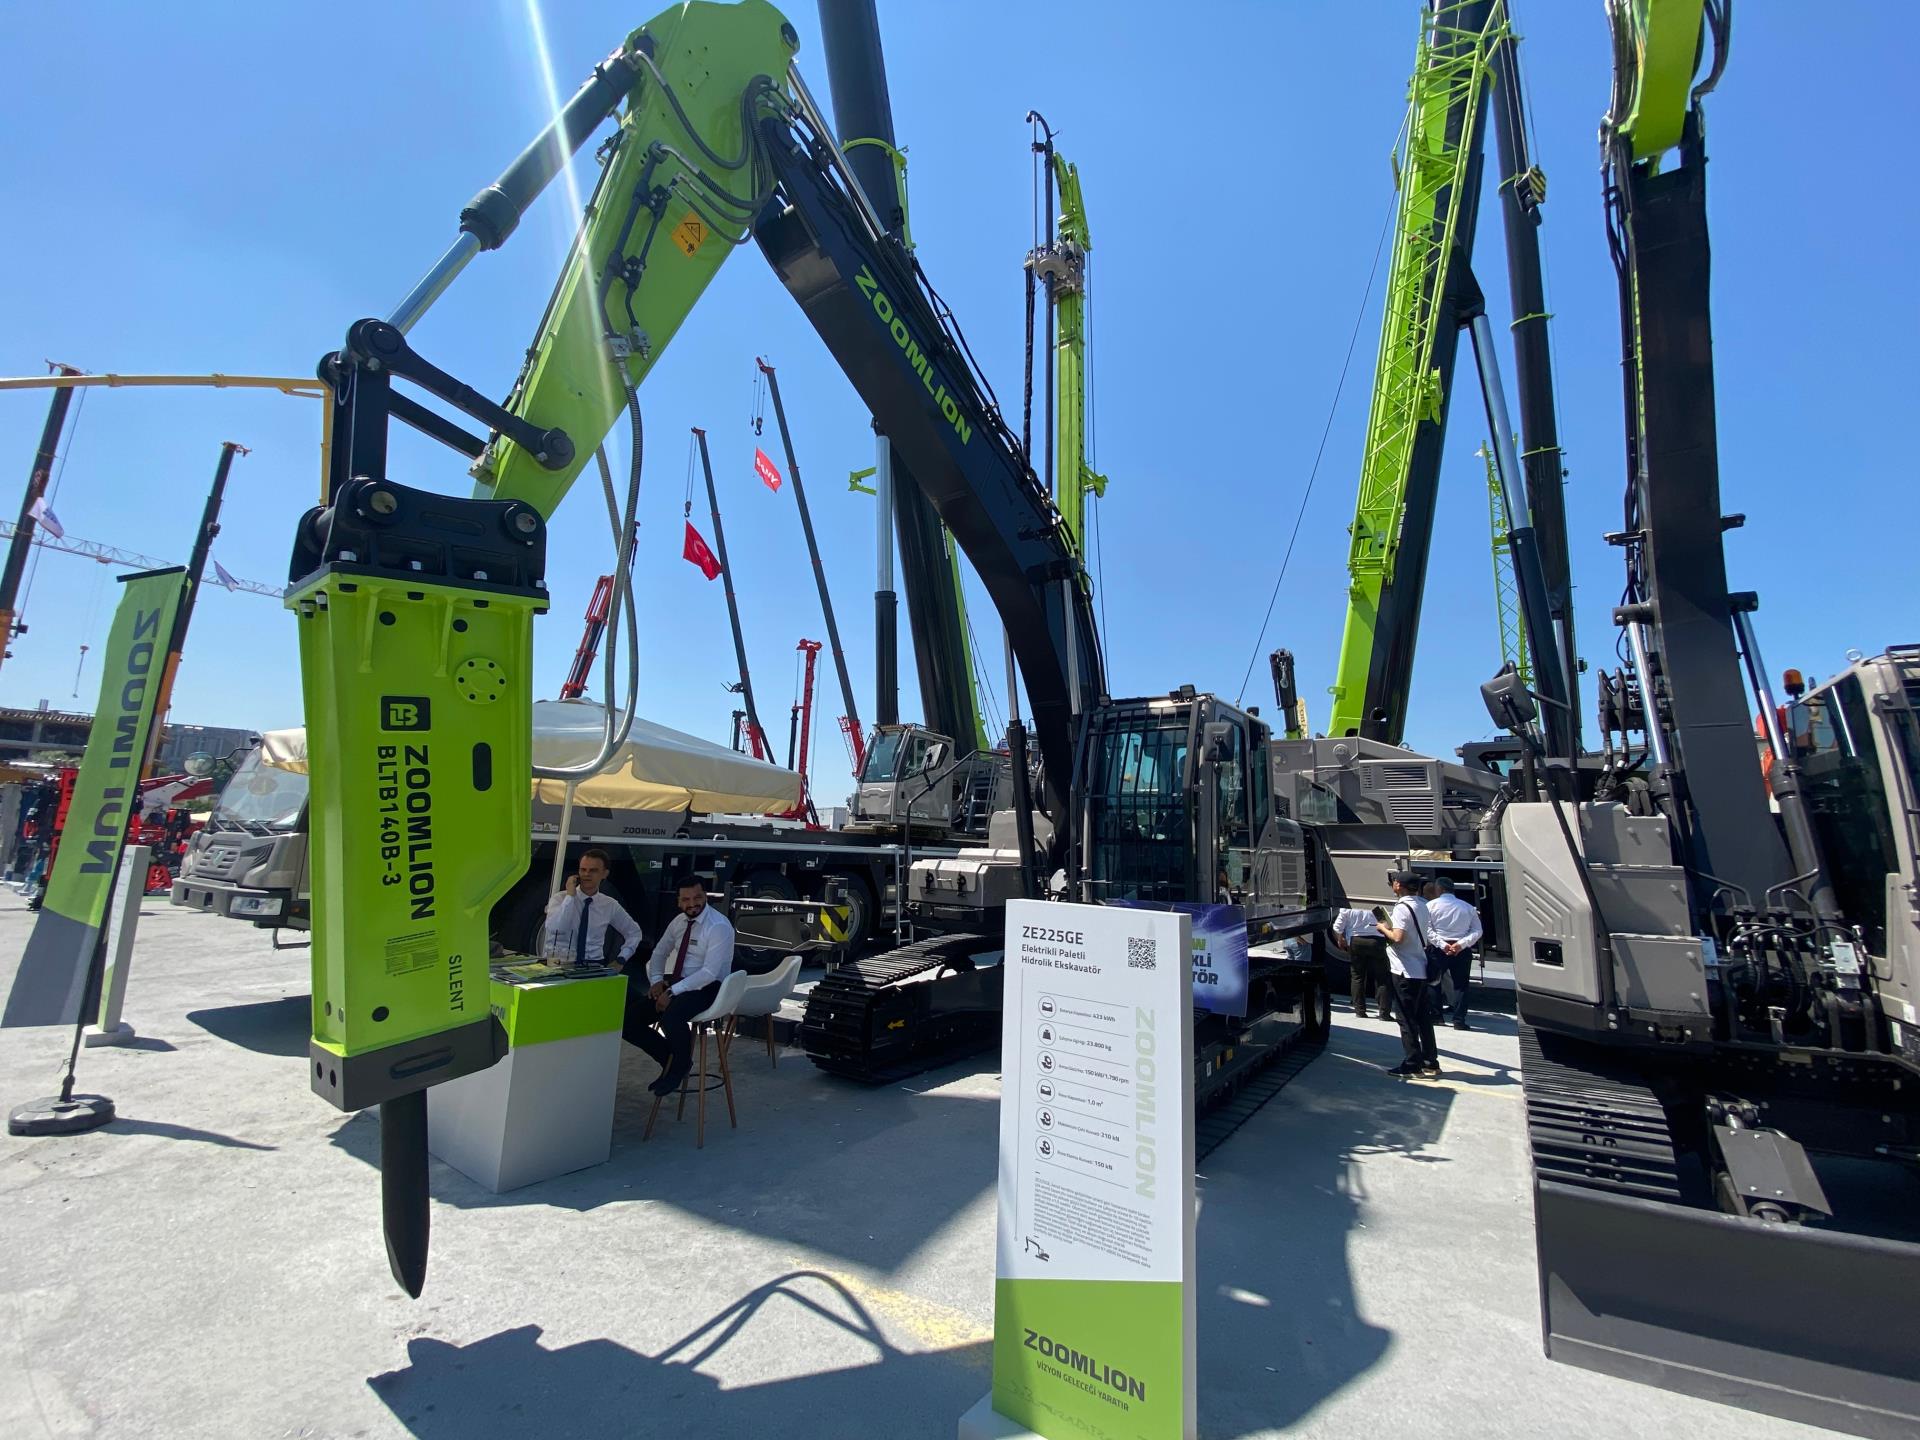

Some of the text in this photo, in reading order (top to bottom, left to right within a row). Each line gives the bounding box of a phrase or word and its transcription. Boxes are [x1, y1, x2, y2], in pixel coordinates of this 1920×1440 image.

[854, 264, 972, 446] ZOOMLION
[377, 745, 402, 887] BLTB140B-3
[404, 744, 436, 920] ZOOMLION
[623, 826, 666, 835] ZOOMLION
[1021, 943, 1086, 960] Elektrikli Paletli
[1022, 925, 1084, 945] ZE225GE
[448, 954, 464, 1012] SILENT
[1021, 955, 1102, 975] Hidrolik Ekskavatör
[1135, 1006, 1157, 1200] ZOOMLION
[1094, 1160, 1105, 1168] 150
[1023, 1327, 1146, 1402] ZOOMLION
[1037, 1359, 1129, 1412] VİZYON GELECEĞİ YARATIR
